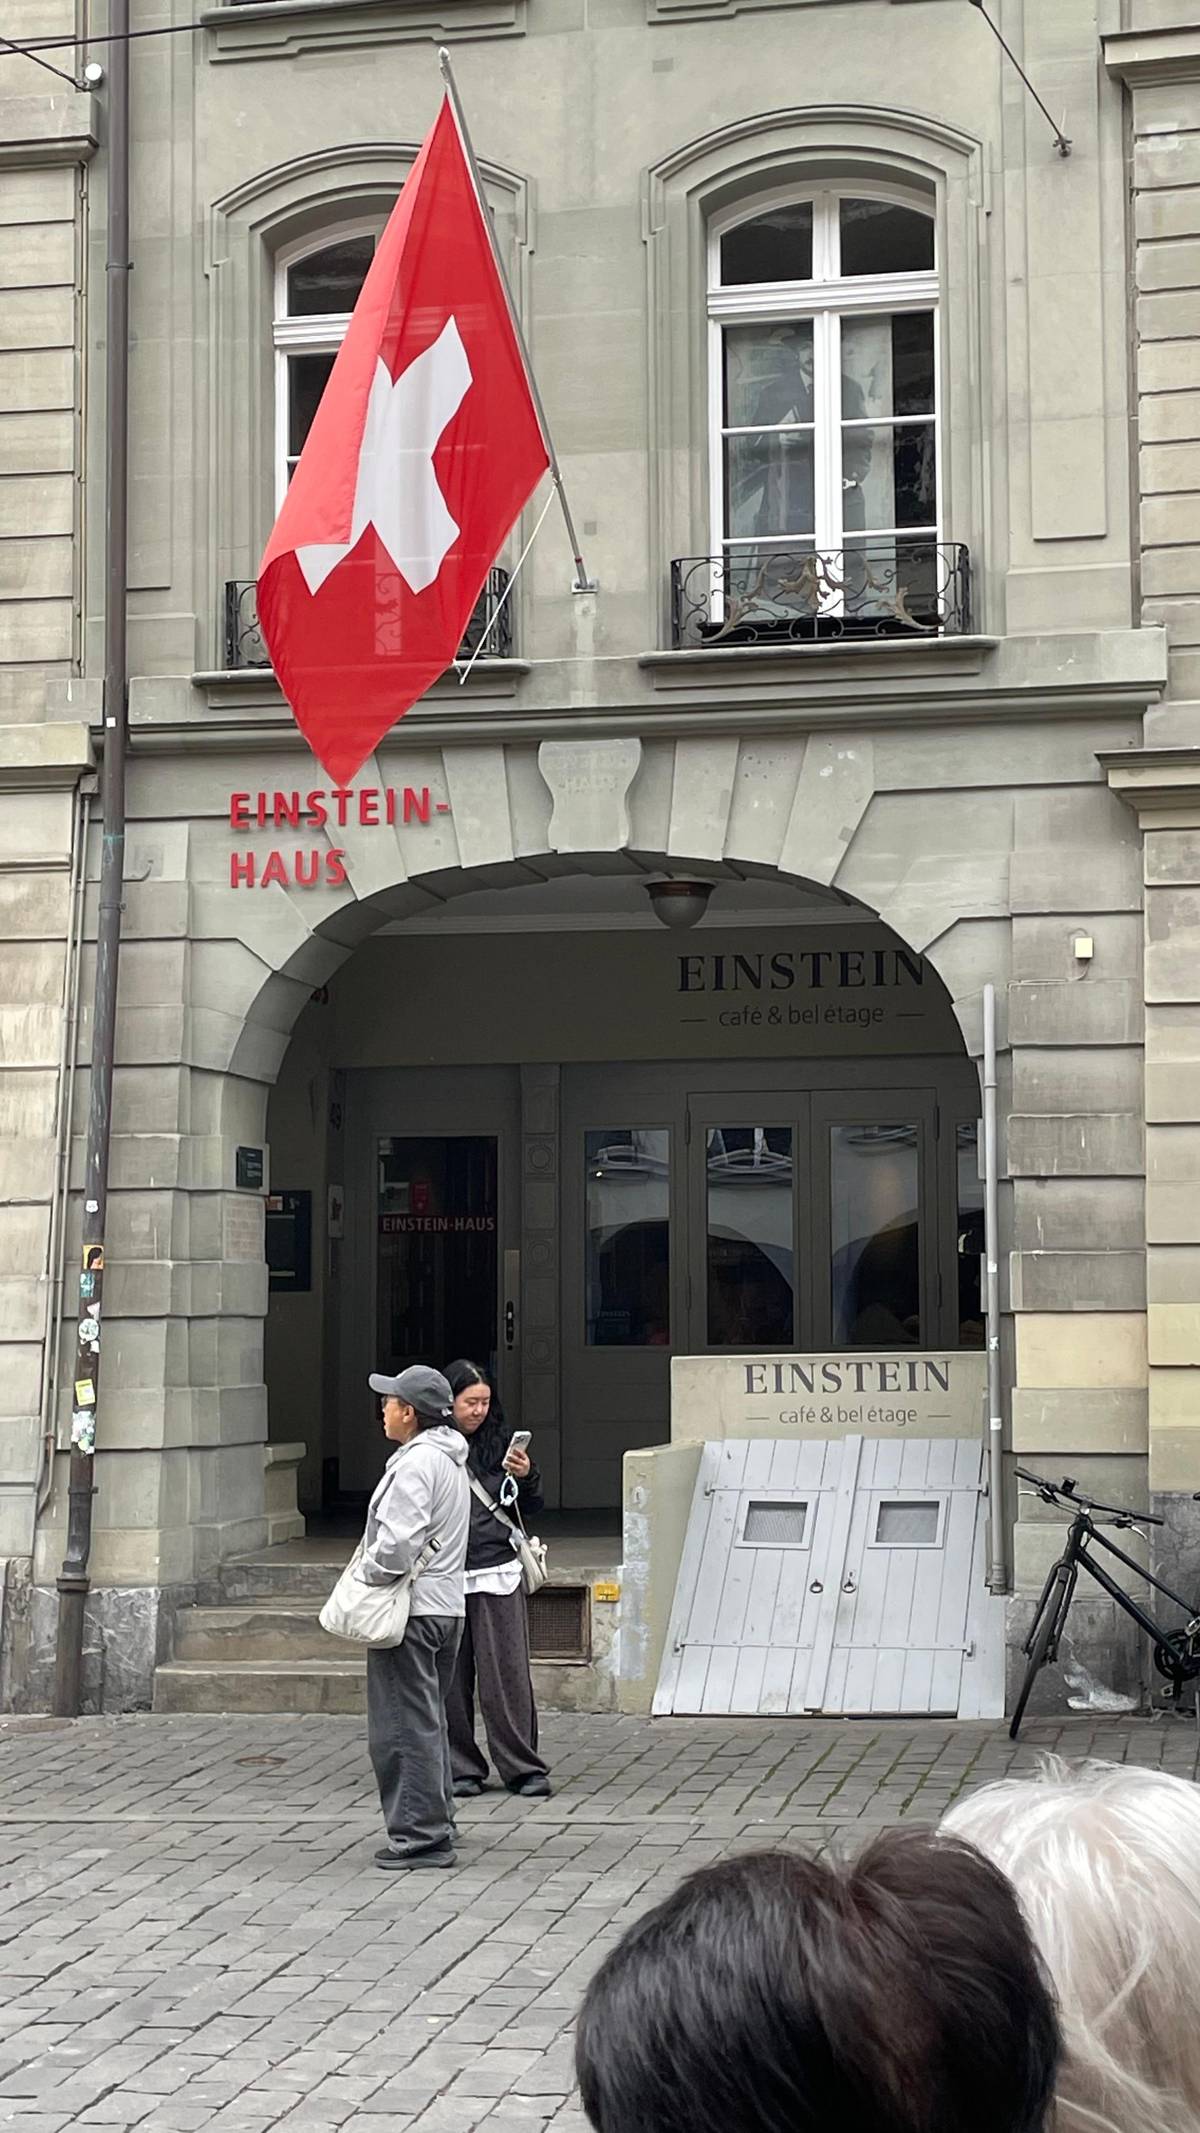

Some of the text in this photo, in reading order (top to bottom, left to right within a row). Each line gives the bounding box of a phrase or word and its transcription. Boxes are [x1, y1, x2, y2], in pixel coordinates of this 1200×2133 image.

[230, 787, 449, 829] EINSTEIN-
[230, 848, 346, 889] HAUS
[676, 950, 924, 992] EINSTEIN
[719, 1004, 884, 1028] café & bel étage
[382, 1216, 495, 1232] EINSTEIN-HAUS
[744, 1360, 952, 1394] EINSTEIN
[779, 1405, 918, 1426] café & bel étage
